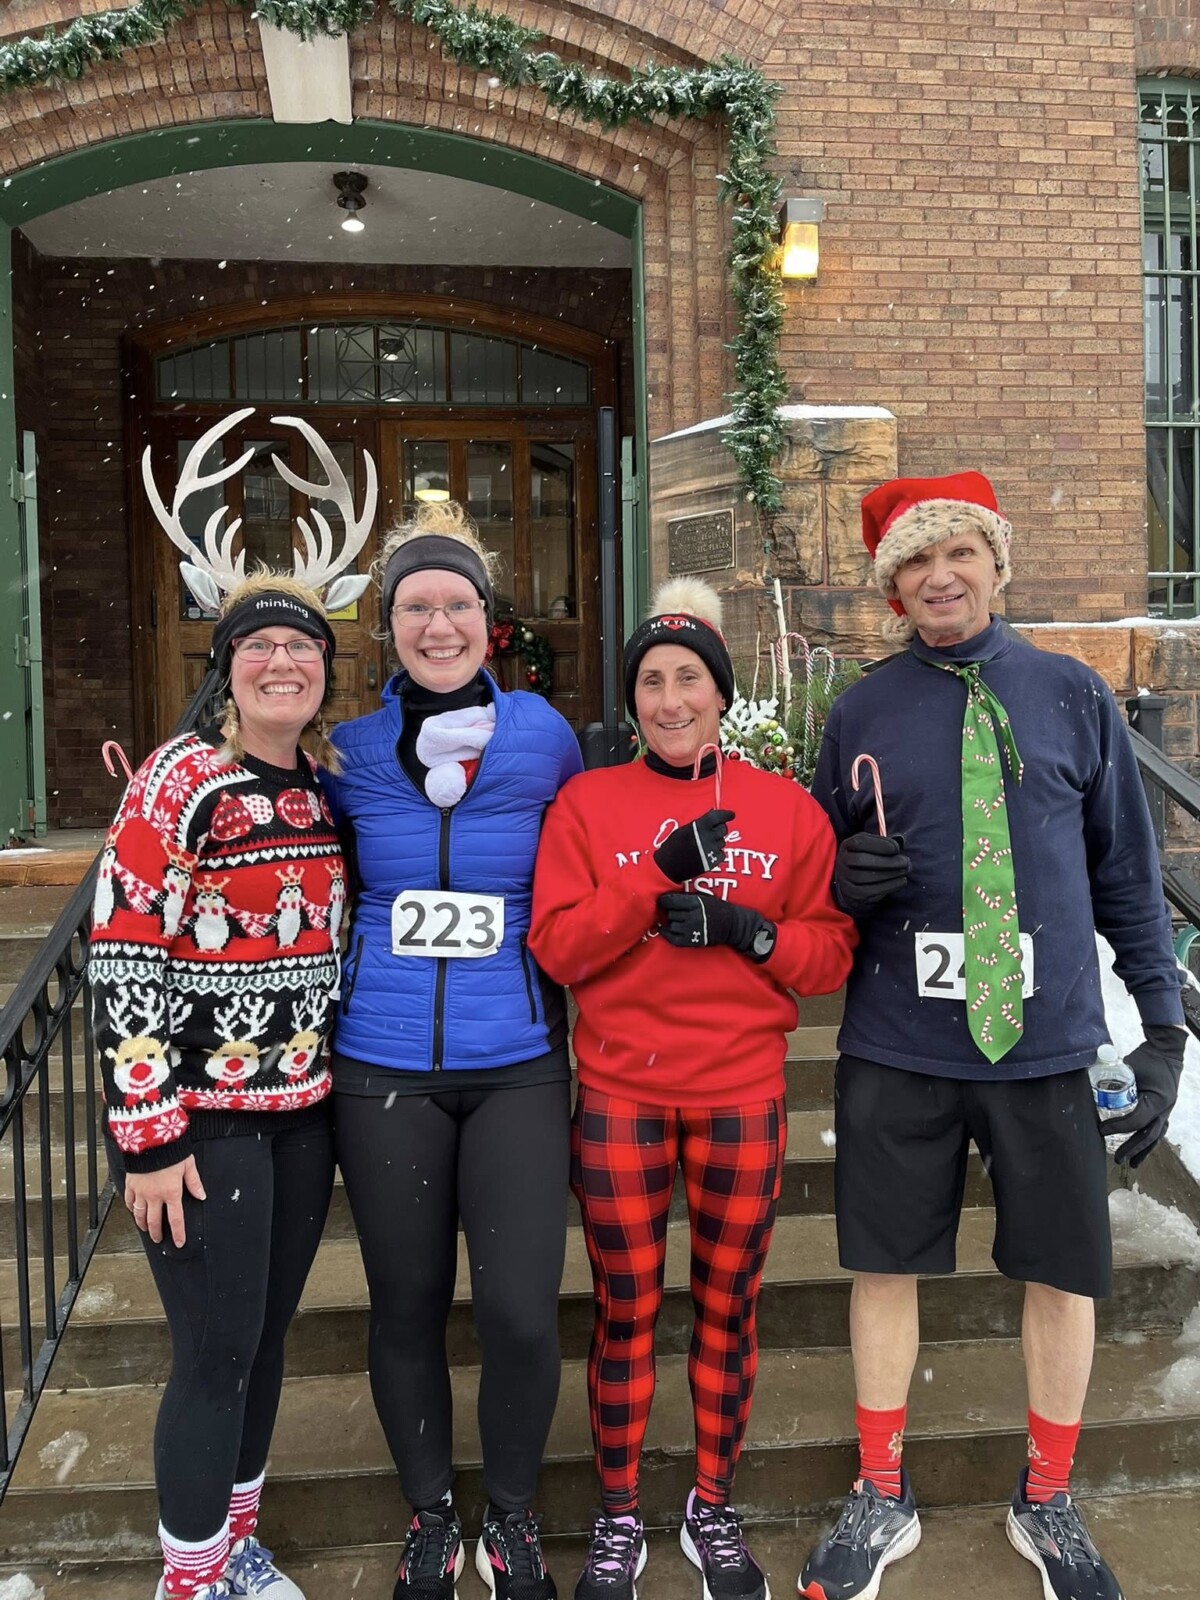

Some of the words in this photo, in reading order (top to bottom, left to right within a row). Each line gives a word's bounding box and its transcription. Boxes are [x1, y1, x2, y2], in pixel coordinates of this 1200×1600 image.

[256, 599, 309, 618] thinking
[651, 620, 669, 630] NEW
[674, 620, 697, 630] YORK
[399, 900, 496, 950] 223
